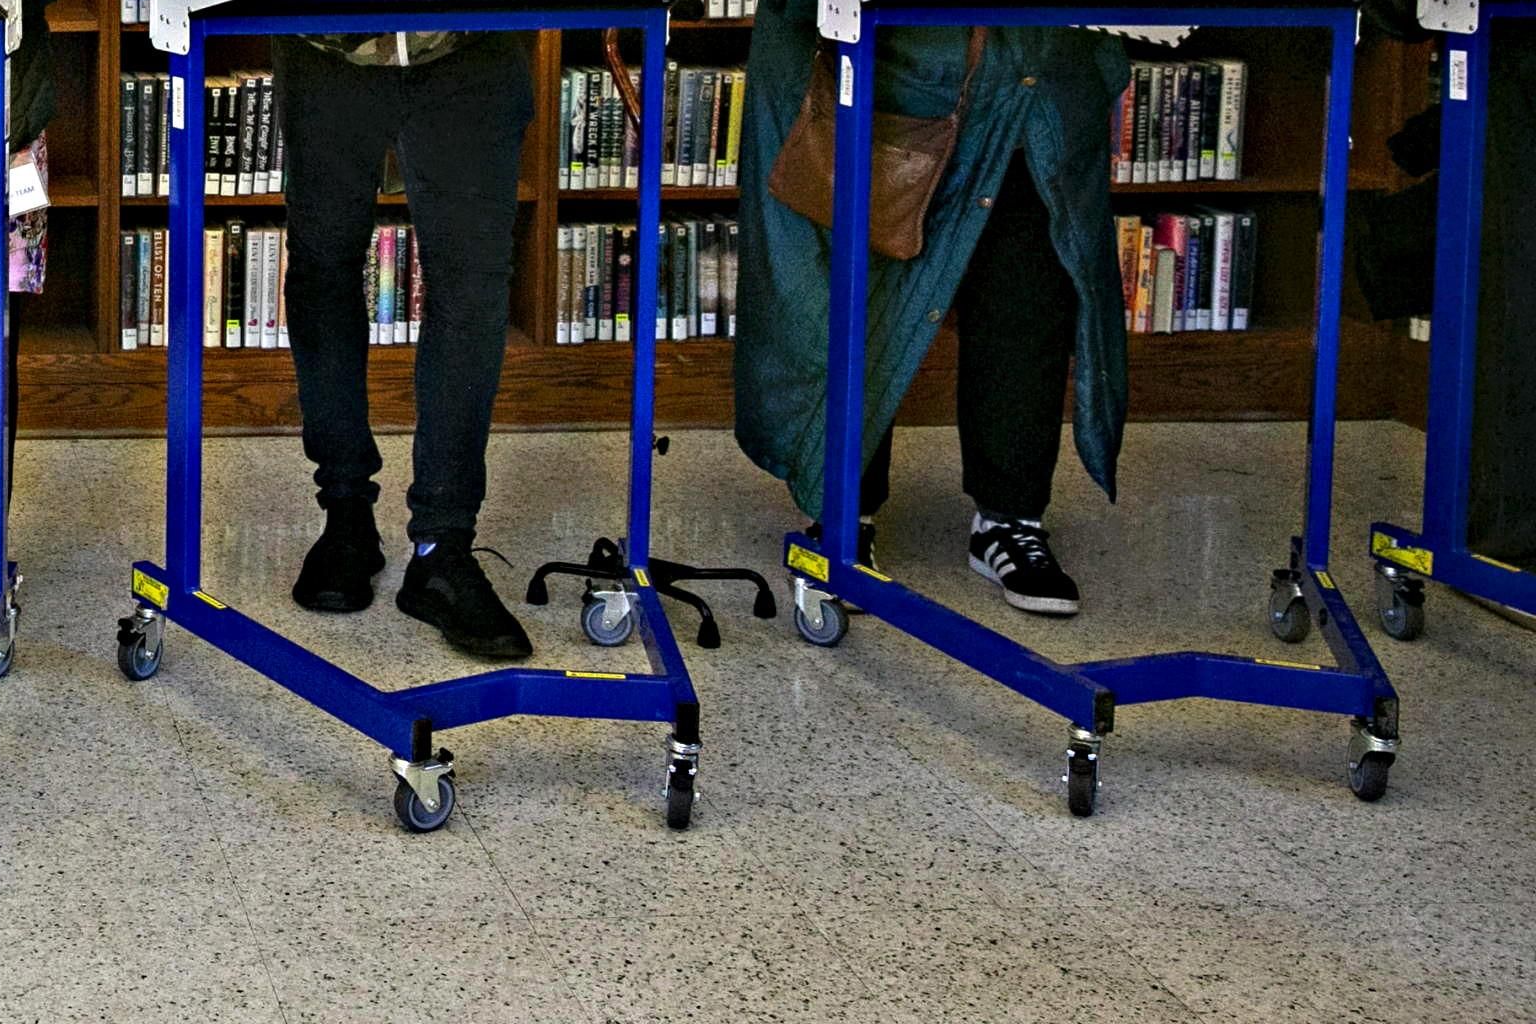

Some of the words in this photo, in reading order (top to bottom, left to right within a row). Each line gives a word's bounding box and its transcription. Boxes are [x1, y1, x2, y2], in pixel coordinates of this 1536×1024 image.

[590, 84, 599, 107] JUST
[589, 111, 599, 146] WRECK
[209, 136, 220, 154] ENVY
[589, 150, 597, 158] IT
[154, 265, 163, 280] OF
[153, 282, 163, 302] TEN
